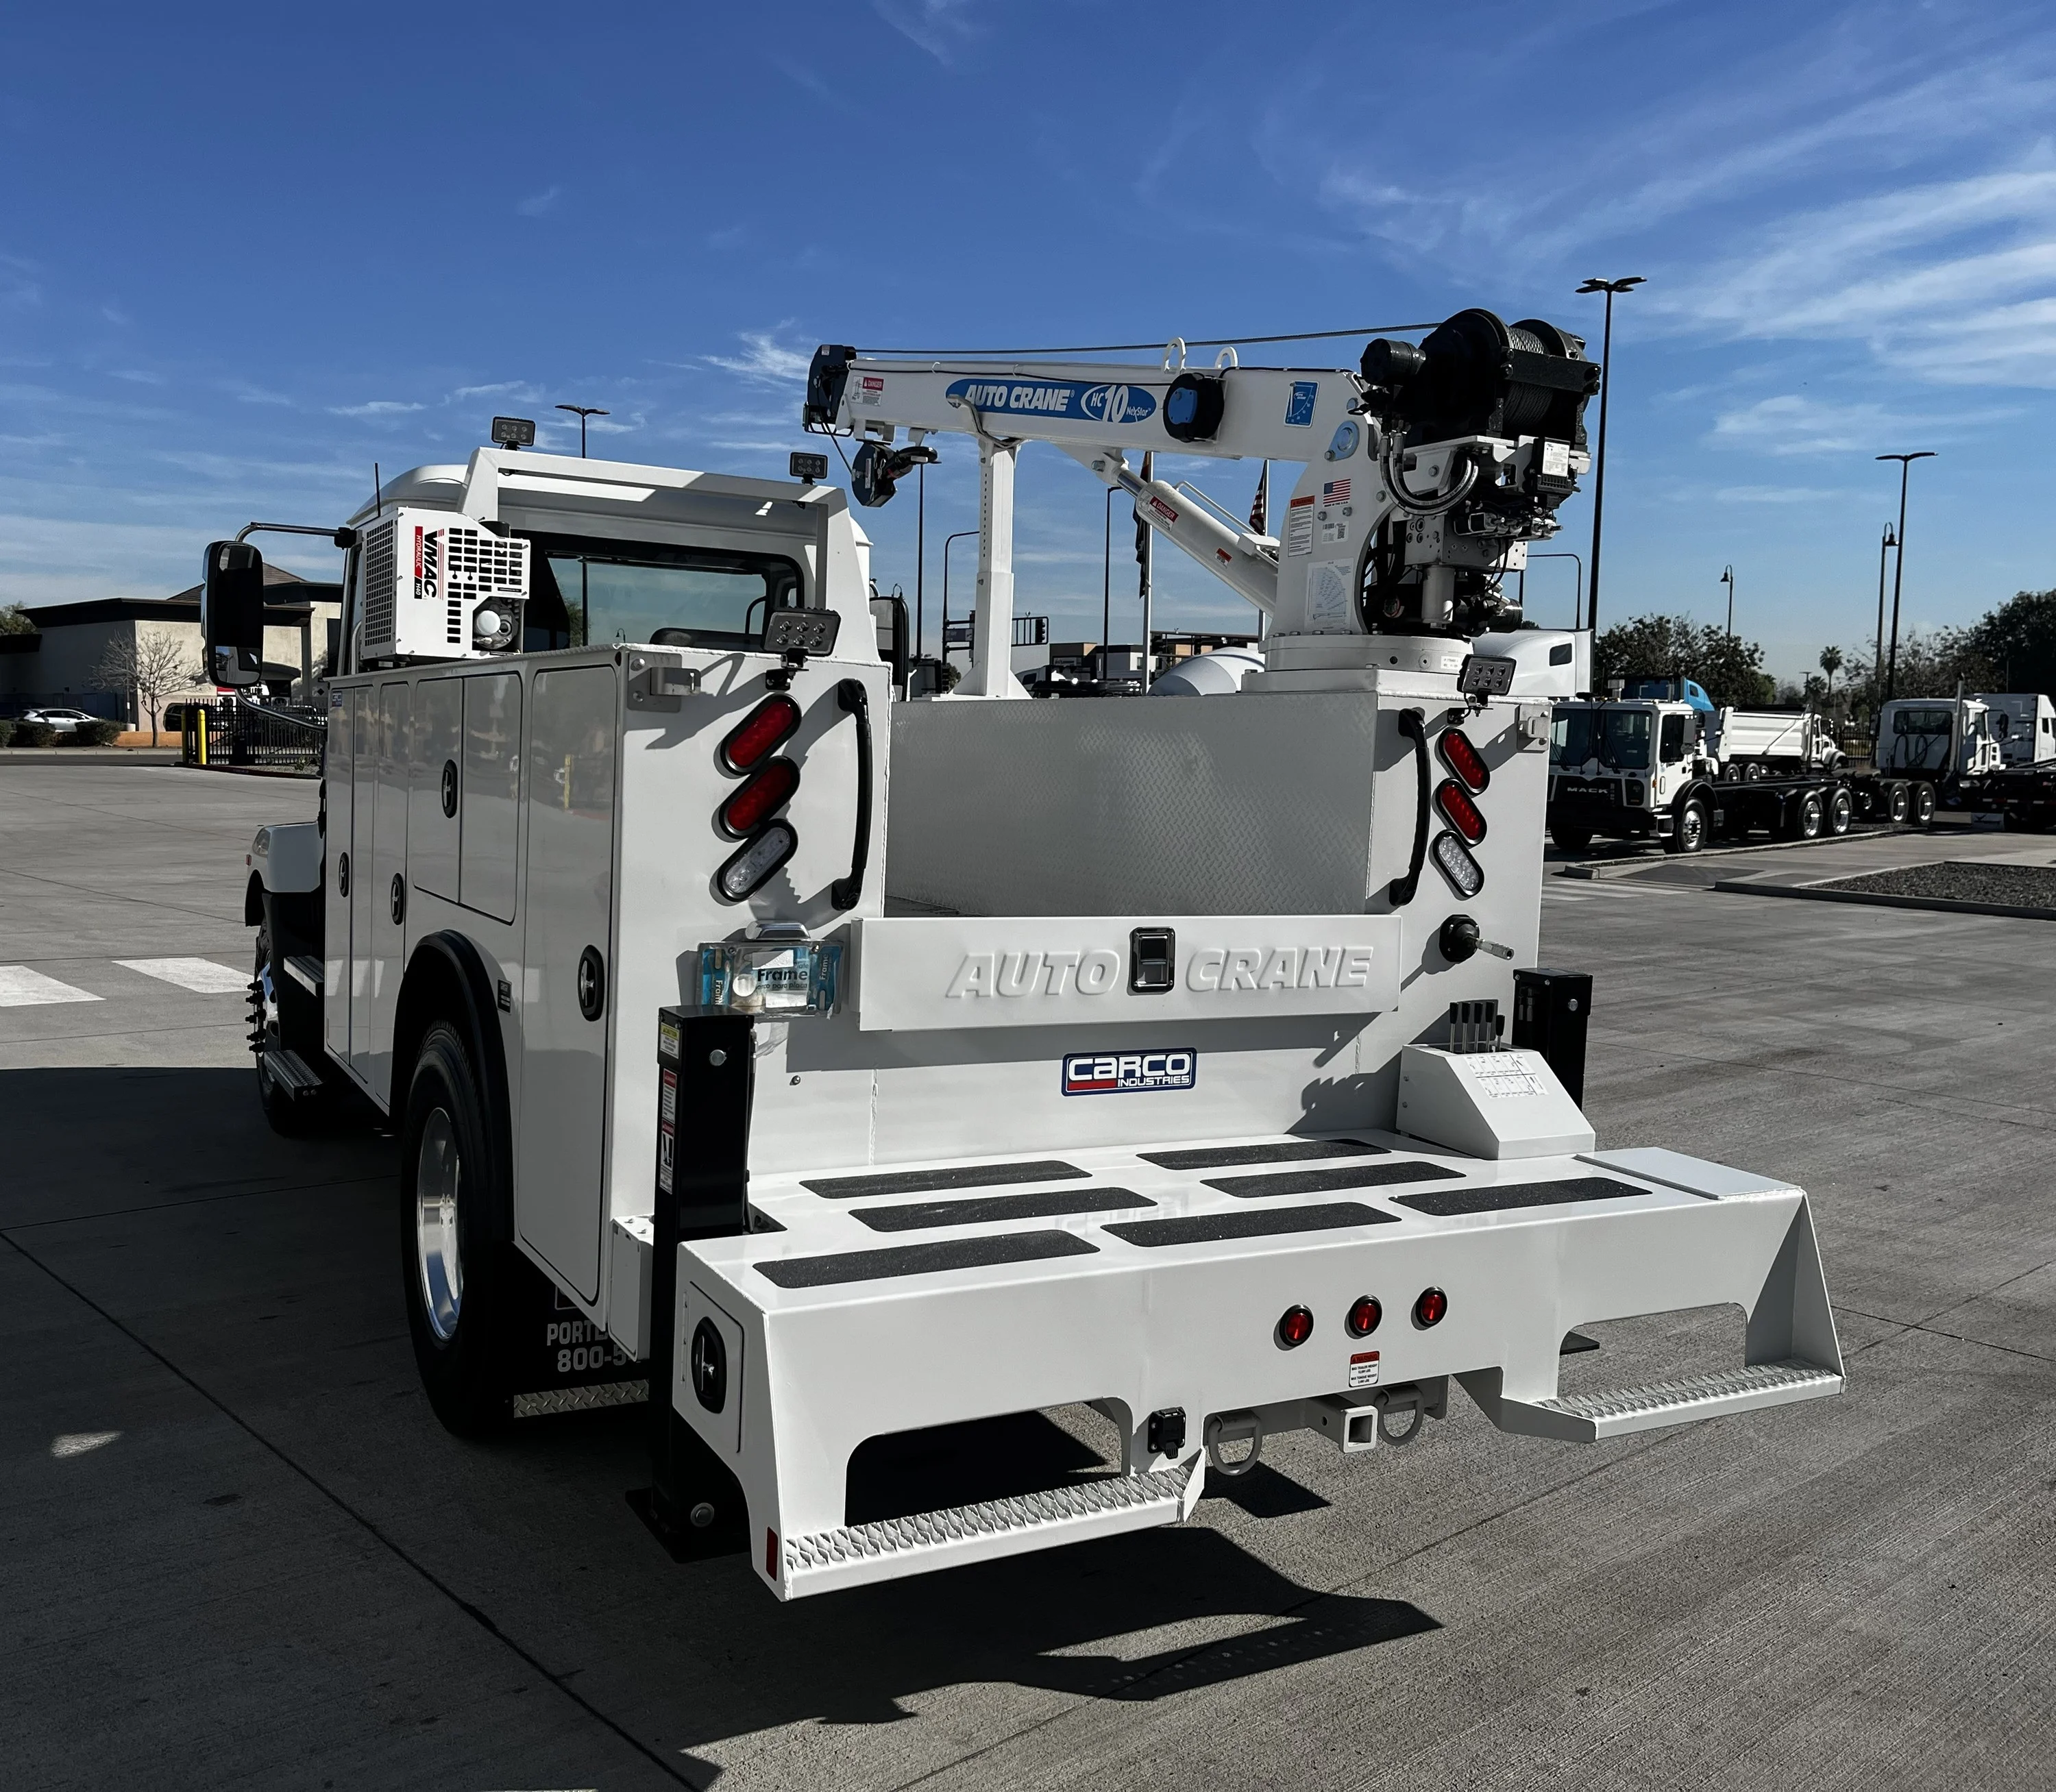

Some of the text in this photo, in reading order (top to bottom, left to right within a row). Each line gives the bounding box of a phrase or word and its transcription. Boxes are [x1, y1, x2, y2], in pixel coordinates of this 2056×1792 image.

[964, 384, 1007, 407] AUTO
[1090, 392, 1105, 407] HC
[1102, 384, 1129, 424] 10
[1156, 502, 1175, 520] DANGER
[424, 530, 437, 598] VMAC
[757, 968, 808, 982] Frame
[819, 953, 829, 981] Frame
[946, 946, 1373, 998] AUTO CRANE
[714, 979, 723, 1005] Fram
[1117, 1075, 1190, 1088] INDUSTRIES
